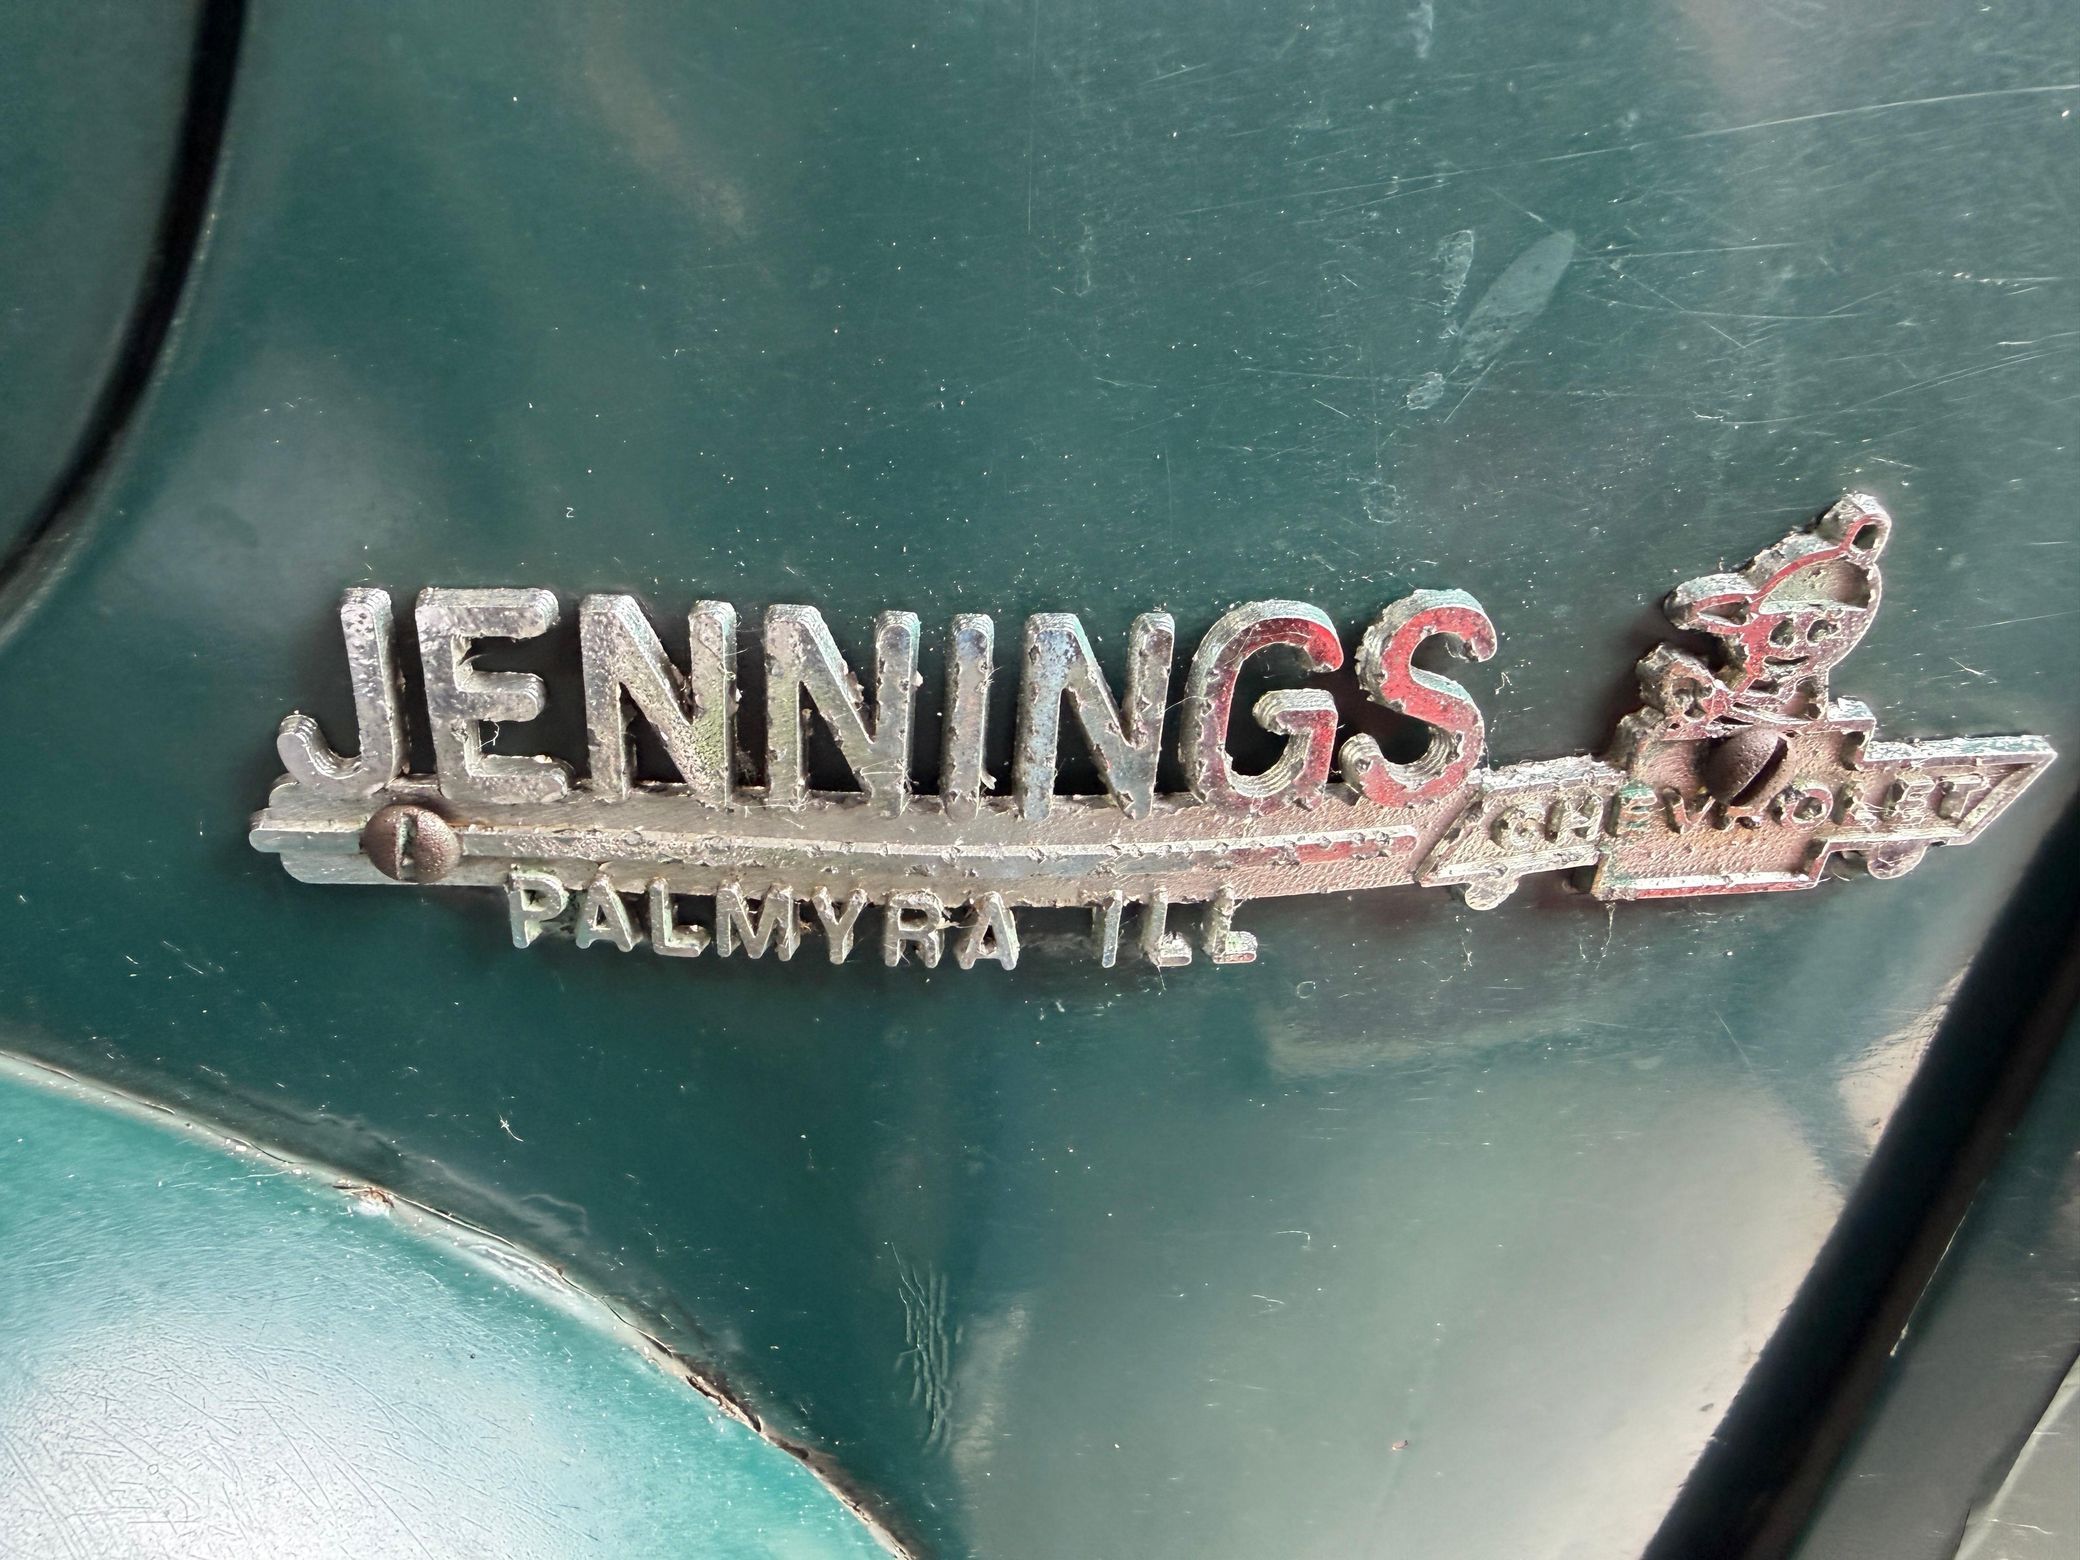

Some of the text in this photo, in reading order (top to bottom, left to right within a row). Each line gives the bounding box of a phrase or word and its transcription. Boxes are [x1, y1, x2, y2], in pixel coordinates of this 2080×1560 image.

[276, 587, 1497, 818] JENNINGS
[506, 868, 1258, 971] PALMYRA ILL
